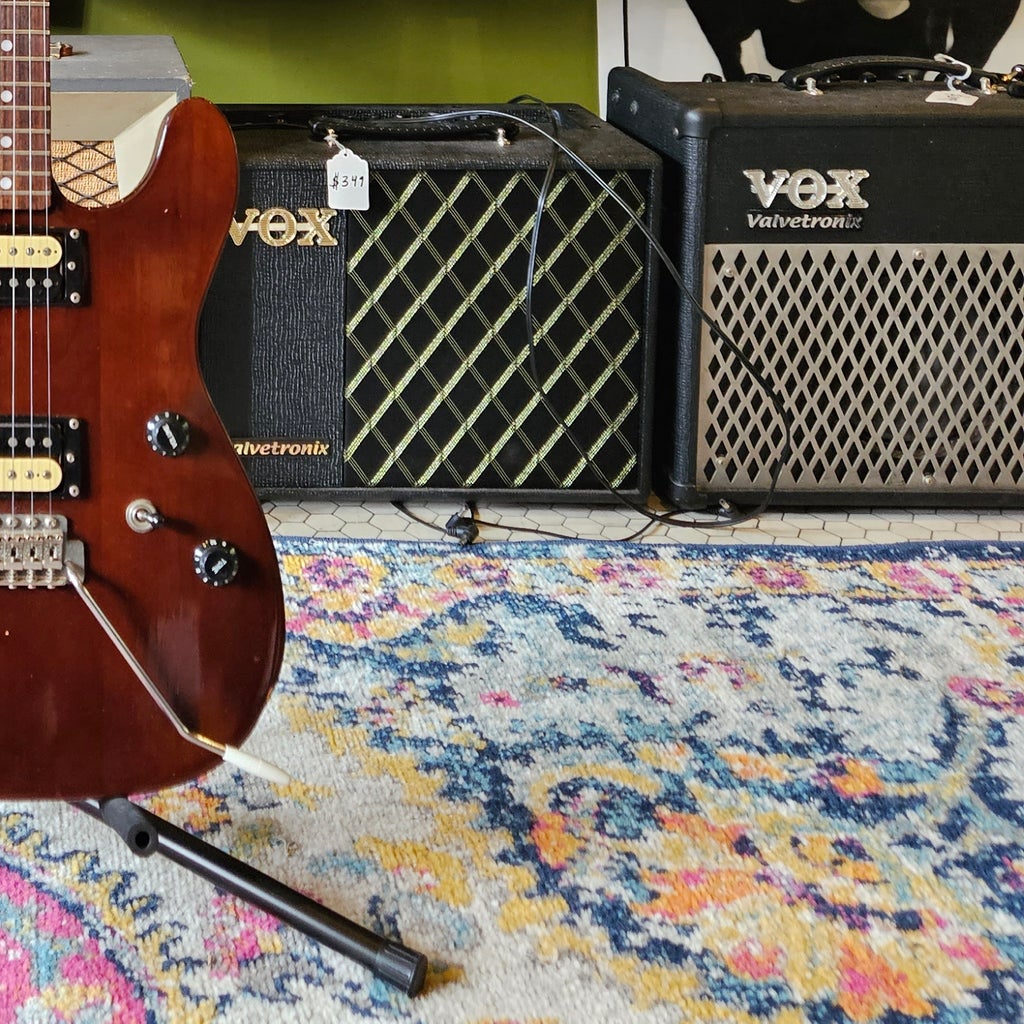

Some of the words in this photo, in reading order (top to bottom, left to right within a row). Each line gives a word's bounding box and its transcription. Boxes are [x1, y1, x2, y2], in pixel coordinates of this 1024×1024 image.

[743, 168, 870, 210] VOX
[229, 207, 338, 246] VOX
[746, 213, 863, 229] Valvetronix
[233, 440, 330, 456] alvetronix
